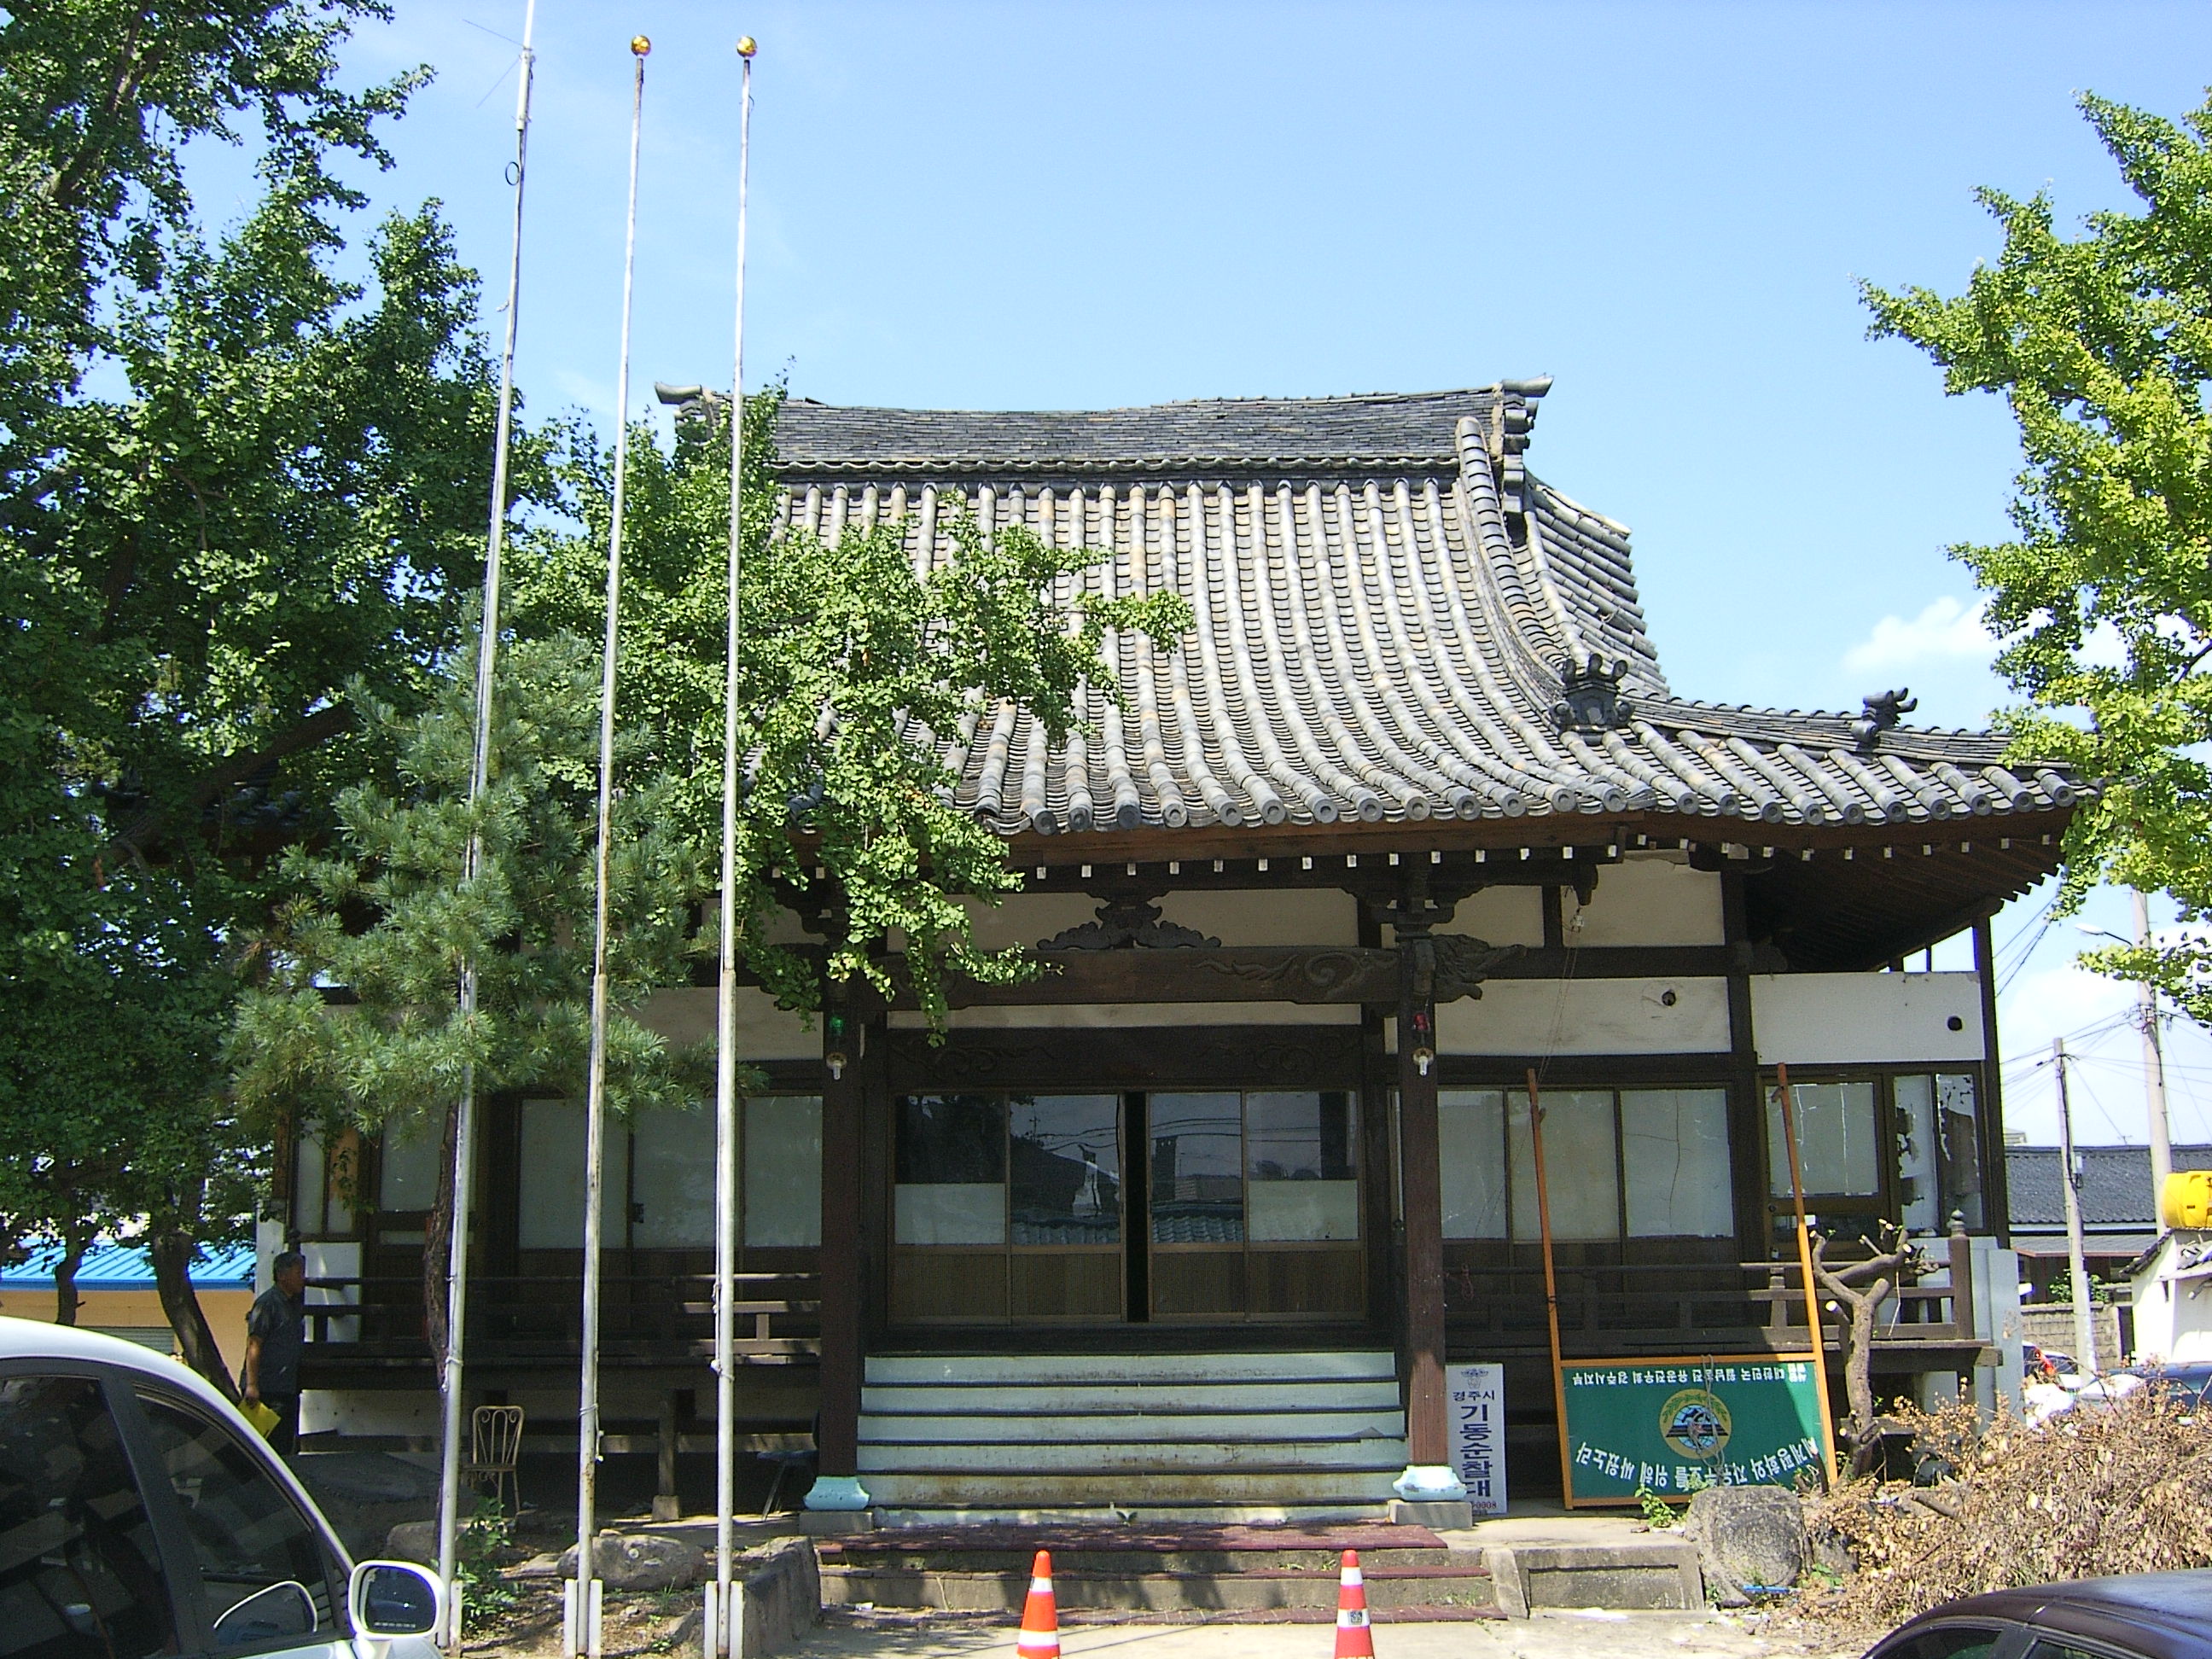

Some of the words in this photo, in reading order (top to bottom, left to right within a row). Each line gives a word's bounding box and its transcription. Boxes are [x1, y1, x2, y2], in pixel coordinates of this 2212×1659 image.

[1572, 1371, 1628, 1386] 경주시지부
[1741, 1367, 1785, 1381] 대한민국
[1452, 1390, 1495, 1401] 경주시
[1459, 1404, 1493, 1497] 기동순찰대
[1575, 1441, 1635, 1481] 싸웠노라
[1639, 1461, 1668, 1487] 위해
